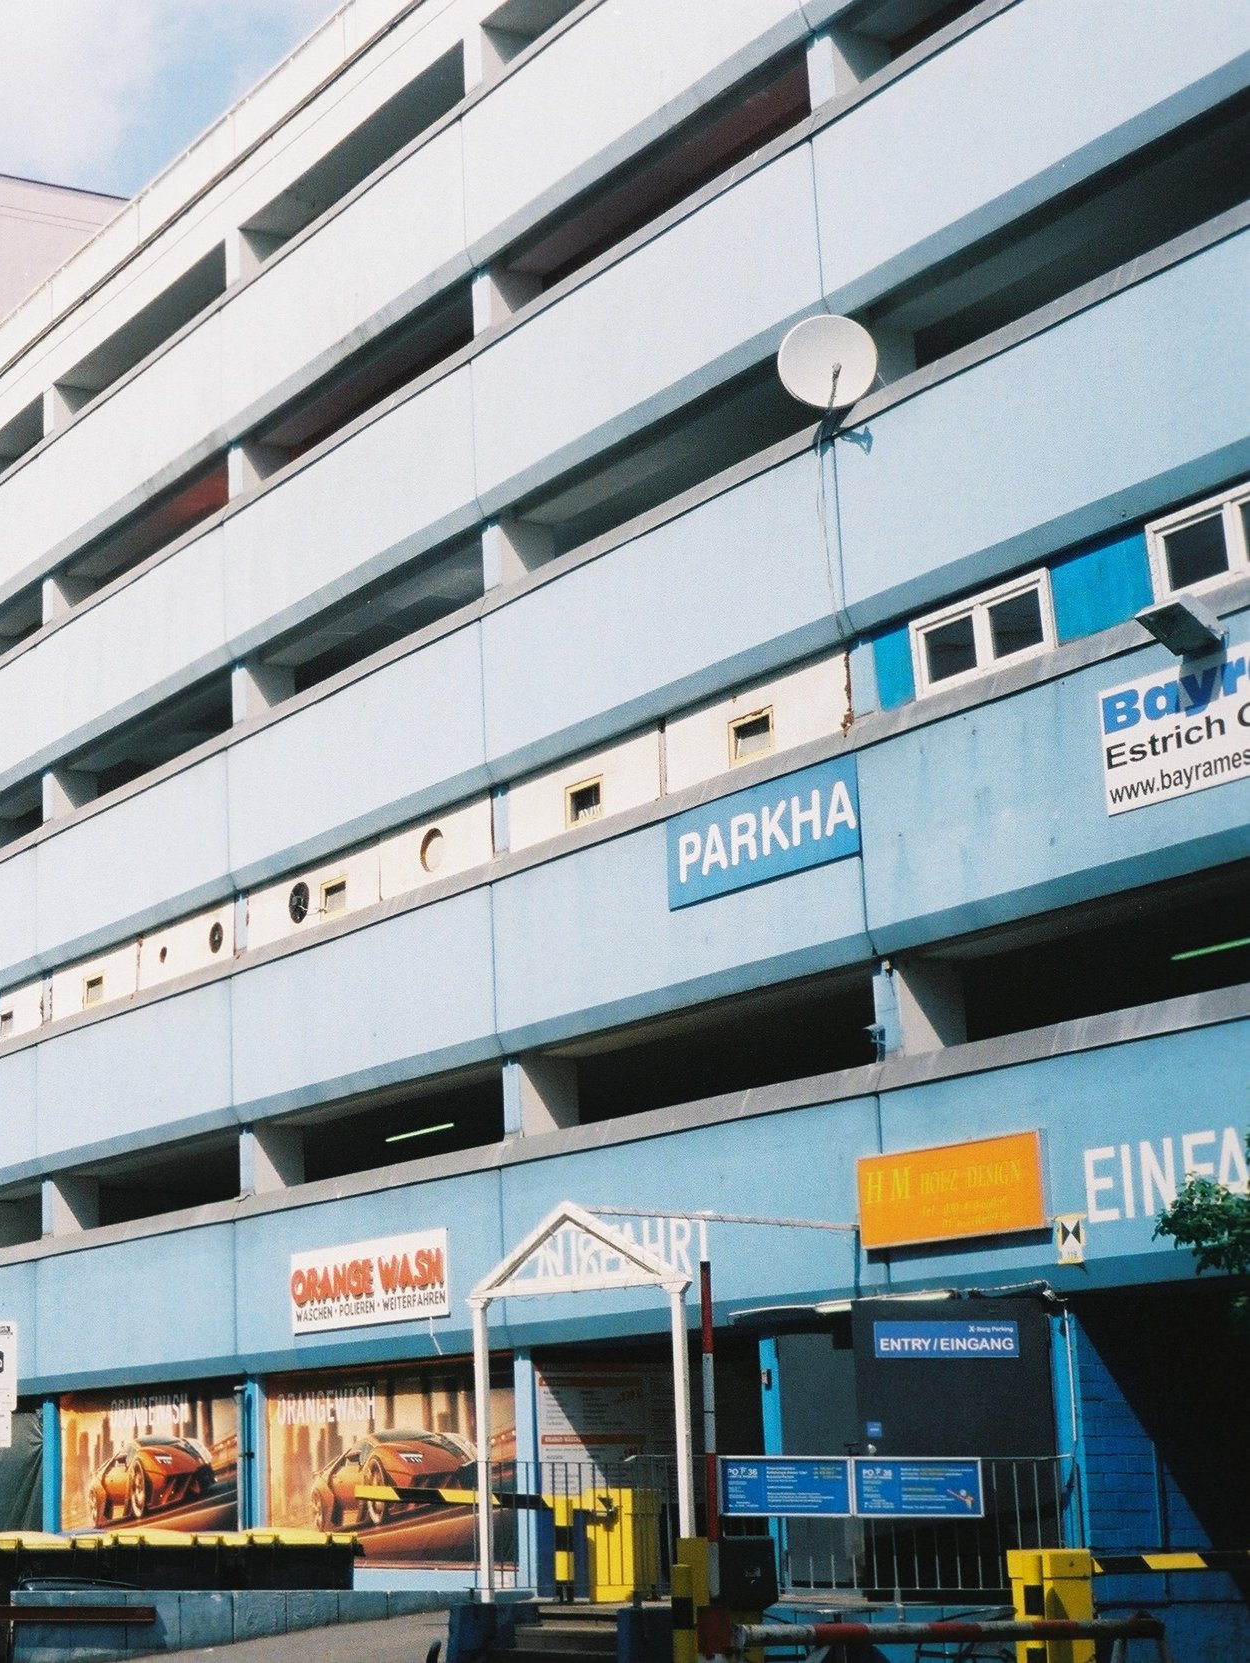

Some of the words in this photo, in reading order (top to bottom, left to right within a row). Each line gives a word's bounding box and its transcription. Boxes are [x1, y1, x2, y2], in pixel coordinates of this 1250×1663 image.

[1102, 656, 1250, 735] Bayr
[1106, 715, 1226, 770] Estrich
[1109, 749, 1250, 805] www.bayrames
[678, 781, 857, 884] PARKHA
[920, 1168, 959, 1195] HOLZ
[966, 1159, 1023, 1188] DESIGN
[291, 1258, 374, 1309] ORANGE
[378, 1247, 444, 1295] WASH
[295, 1306, 333, 1322] WASCHEN
[338, 1301, 376, 1317] POLIEREN
[382, 1290, 447, 1311] WEITERFAHREN
[277, 1386, 375, 1425] ORANGEWASH
